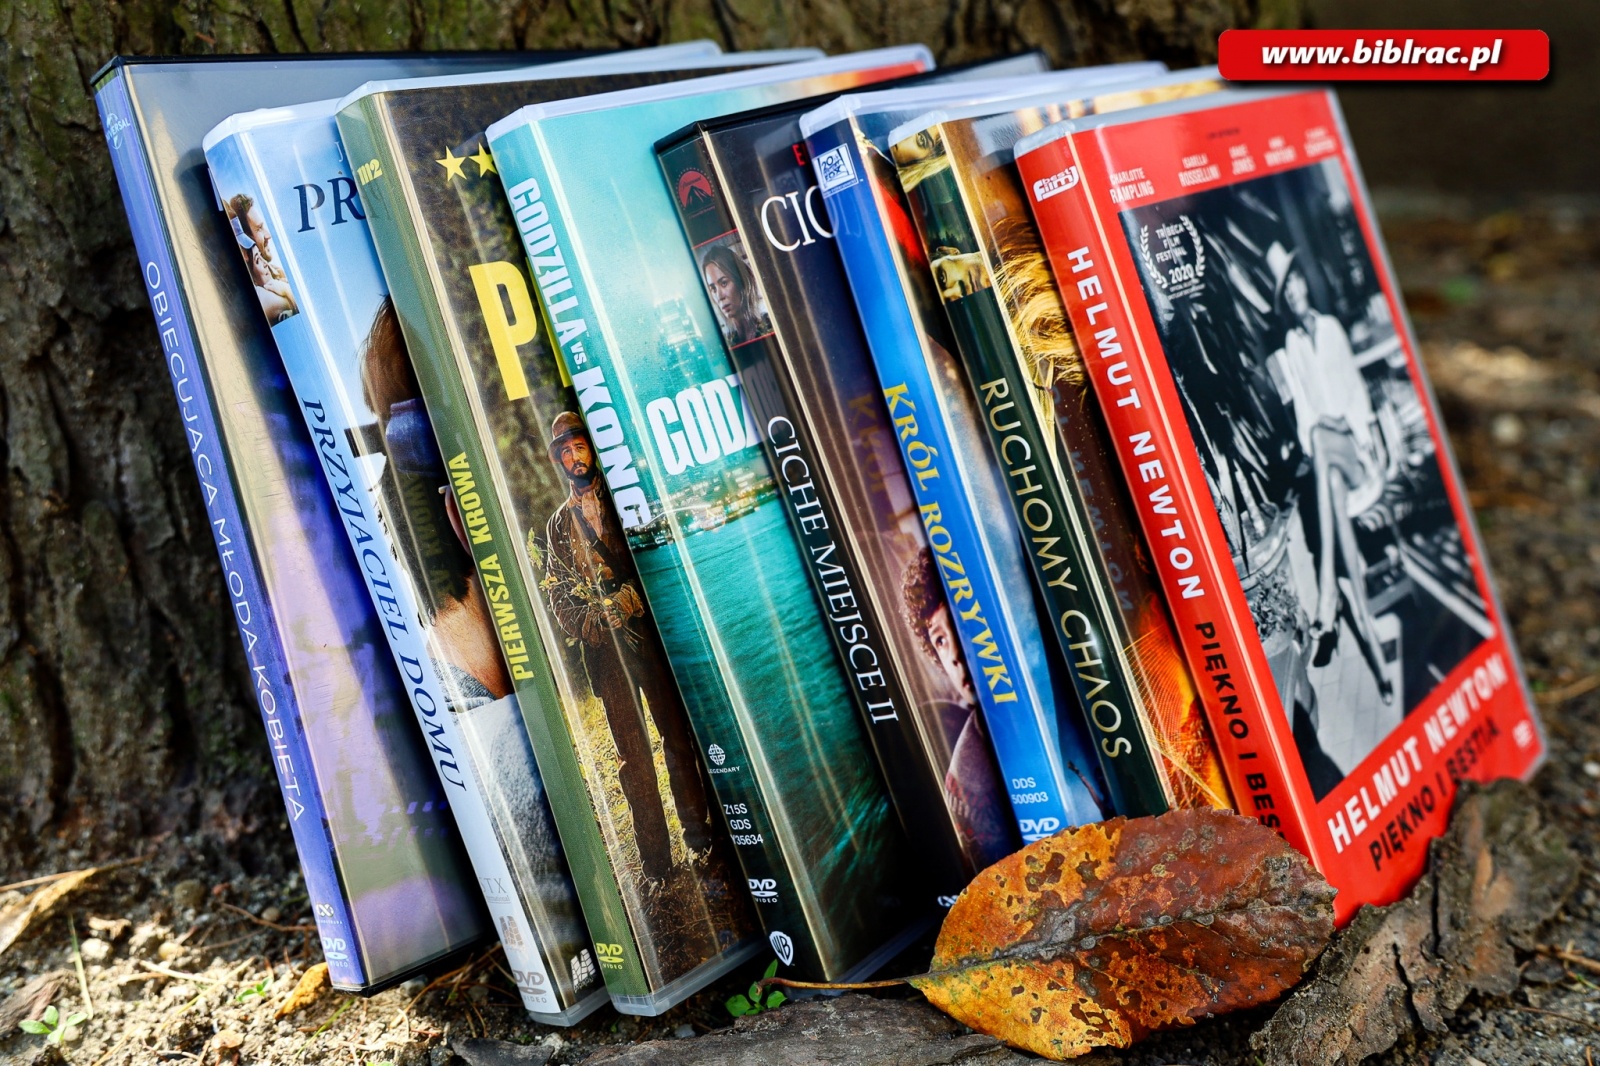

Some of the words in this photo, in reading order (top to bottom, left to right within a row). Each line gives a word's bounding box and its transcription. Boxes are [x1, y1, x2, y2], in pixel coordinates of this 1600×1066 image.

[1109, 167, 1146, 186] CHARLOTTE
[1109, 180, 1155, 204] RAMPLING
[1155, 222, 1185, 240] TRIBECA
[1162, 234, 1181, 249] FILM
[1155, 244, 1188, 264] FESTIVAL
[1168, 262, 1196, 285] 2020
[1067, 246, 1142, 410] HELMUT
[509, 177, 587, 346] GODZILLA
[572, 366, 650, 528] KONG
[447, 450, 493, 547] KROWA
[1128, 429, 1205, 602] NEWTON
[883, 381, 941, 492] KRÓL
[920, 499, 1019, 704] ROZRYWKI
[766, 415, 830, 536] CICHE
[810, 540, 887, 692] MIEJSCE
[866, 697, 899, 725] II
[979, 376, 1078, 594] RUCHOMY
[1060, 608, 1133, 760] CHAOS
[302, 396, 409, 643] PRZYJACIEL
[399, 650, 468, 792] DOMU
[478, 552, 536, 680] PIERWSZA
[213, 517, 258, 653] MŁODA
[252, 665, 306, 822] KOBIETA
[1195, 622, 1250, 740] PIĘKNO
[1238, 752, 1257, 760] I
[1326, 738, 1426, 854] HELMUT
[1423, 652, 1508, 756] NEWTON
[1012, 777, 1037, 789] DDS
[1011, 791, 1049, 805] 500903
[1245, 772, 1285, 840] BES
[730, 818, 752, 831] GDS
[1019, 817, 1060, 834] DVD
[1368, 784, 1436, 872] PIĘKNO
[748, 878, 777, 892] DVD
[323, 936, 347, 953] DVD
[595, 942, 624, 956] DVD
[513, 969, 545, 987] DVD
[602, 963, 624, 971] VIDEO
